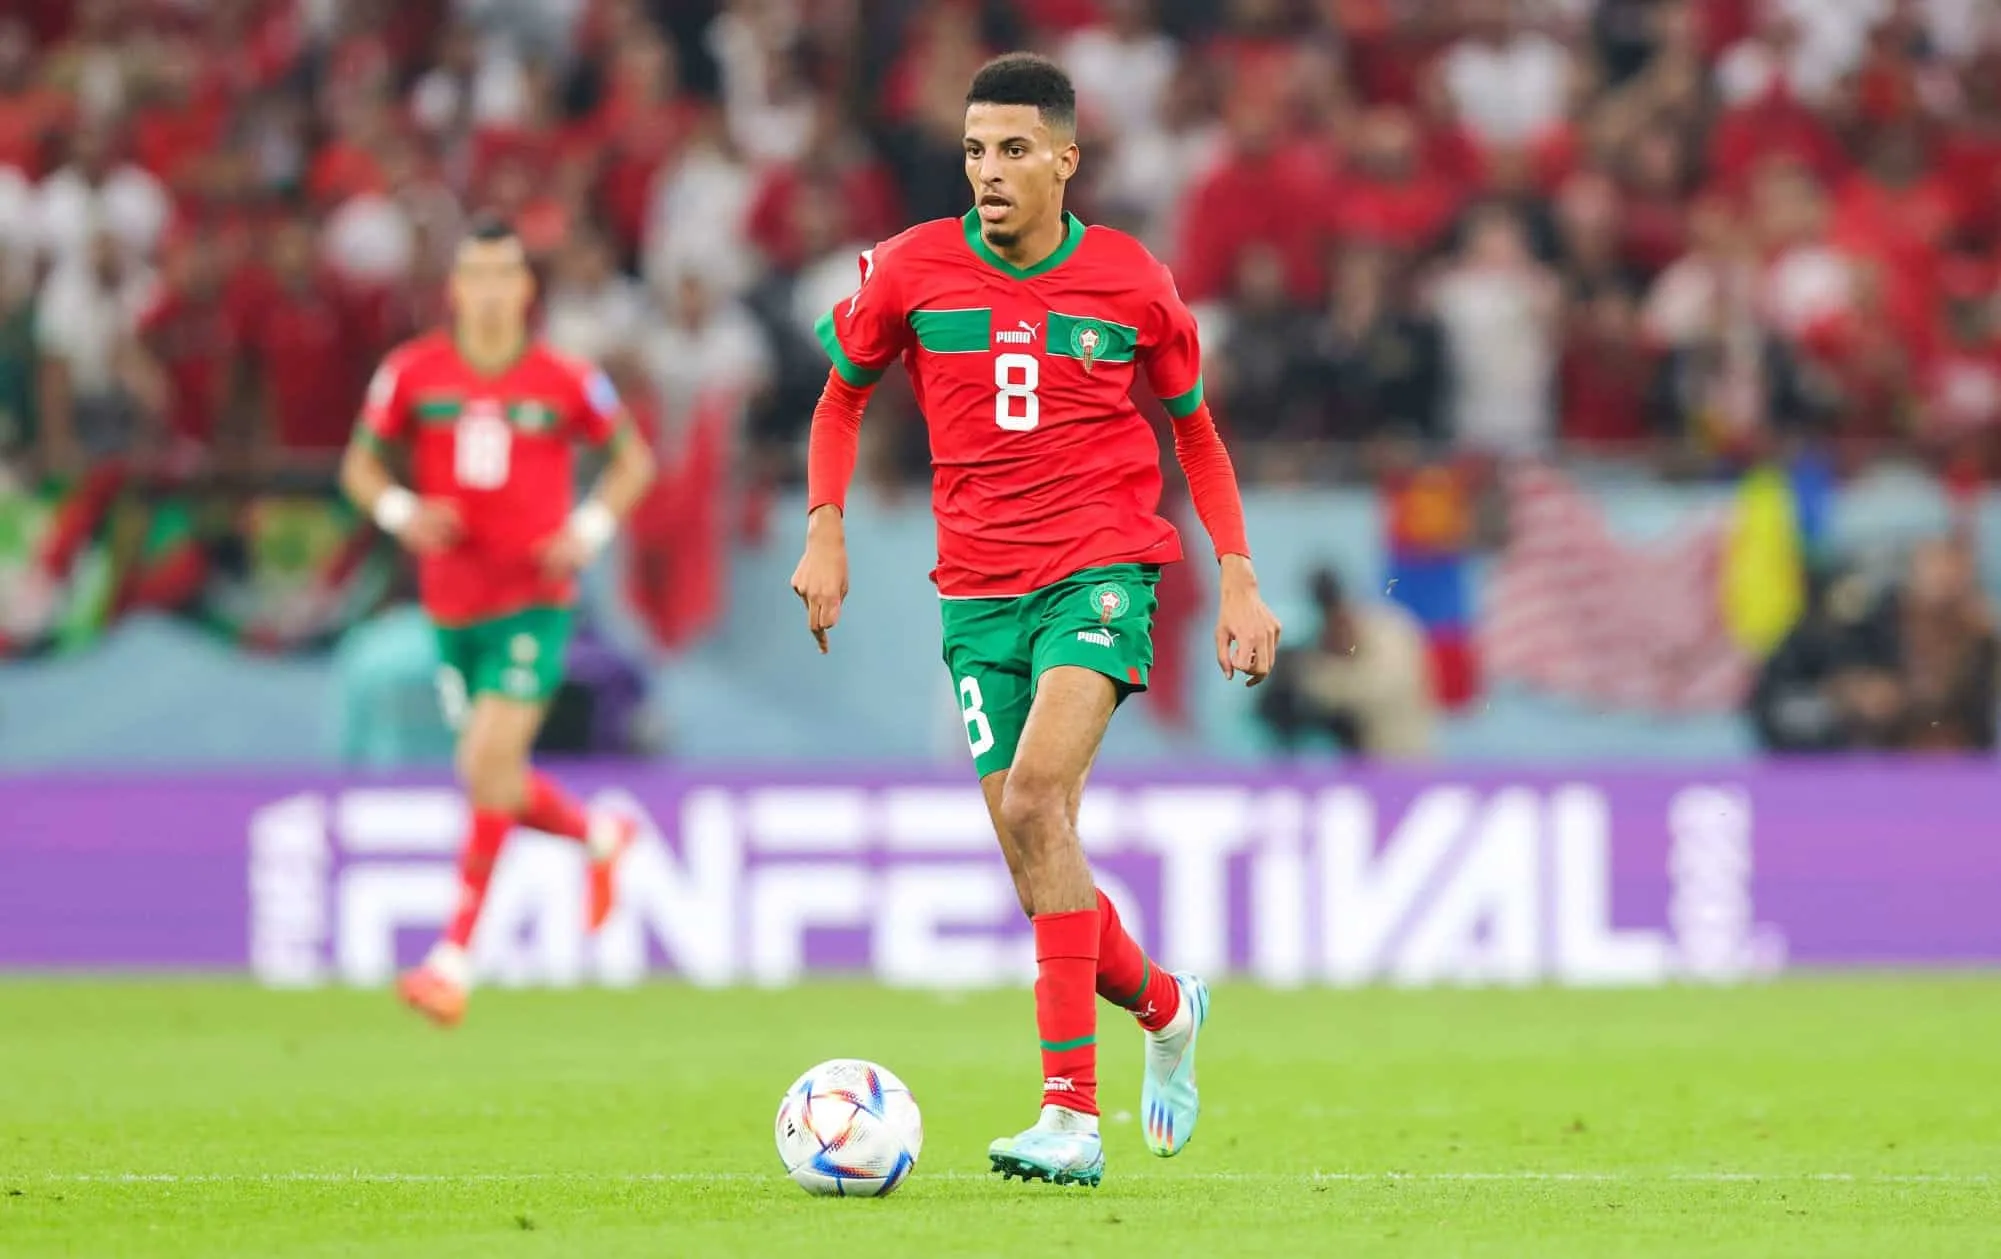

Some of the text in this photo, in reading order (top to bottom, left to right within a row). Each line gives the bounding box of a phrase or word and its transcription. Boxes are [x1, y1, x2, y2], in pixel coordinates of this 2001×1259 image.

[995, 331, 1031, 344] PUMA
[994, 353, 1040, 432] 8
[1077, 631, 1111, 648] PUMA
[959, 675, 995, 759] 8
